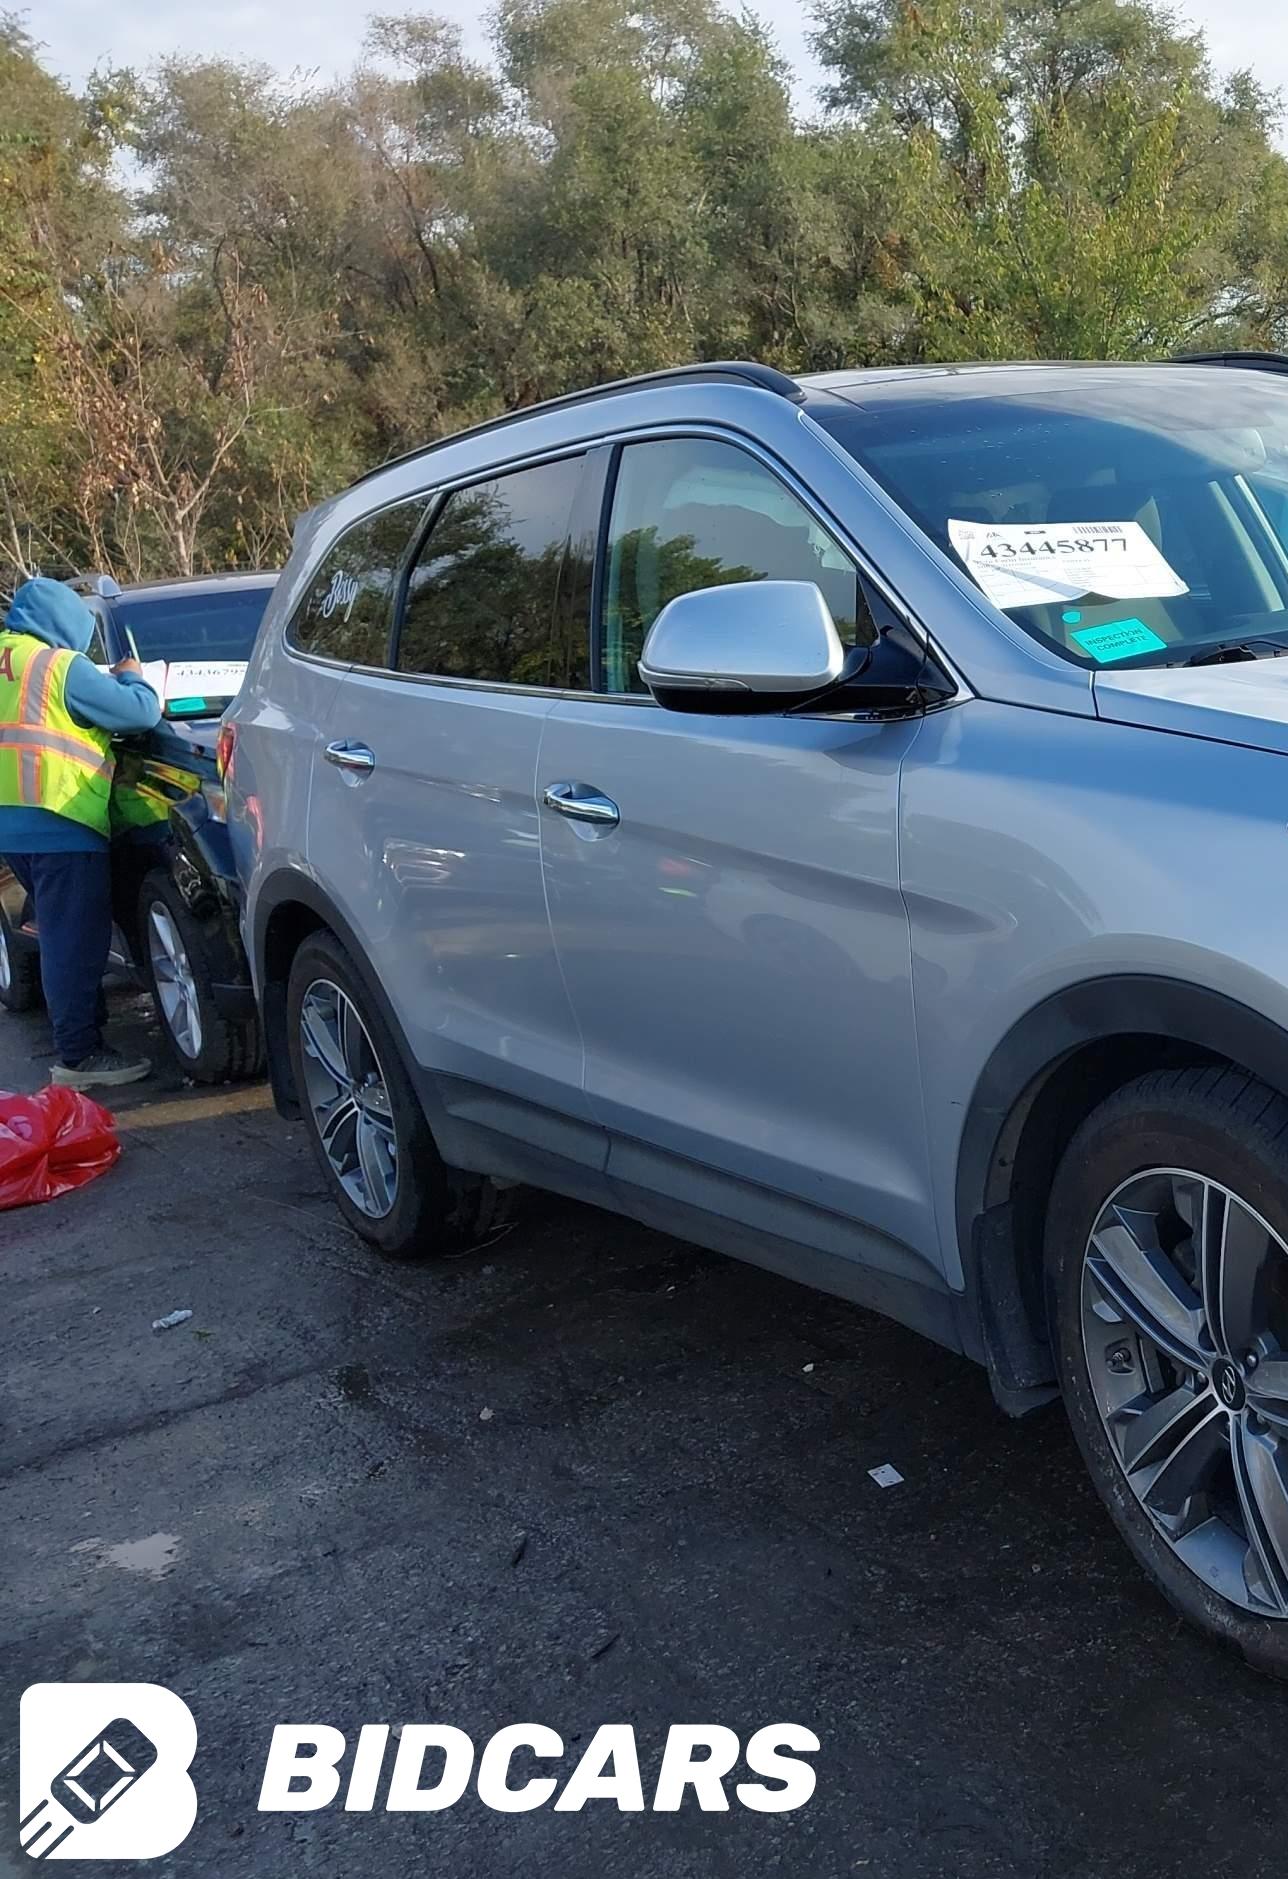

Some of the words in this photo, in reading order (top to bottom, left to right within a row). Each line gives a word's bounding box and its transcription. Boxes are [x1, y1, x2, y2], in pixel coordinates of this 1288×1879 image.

[981, 537, 1127, 558] 43445877
[1084, 628, 1144, 646] INSPECTION
[1096, 635, 1149, 651] COMPLETE
